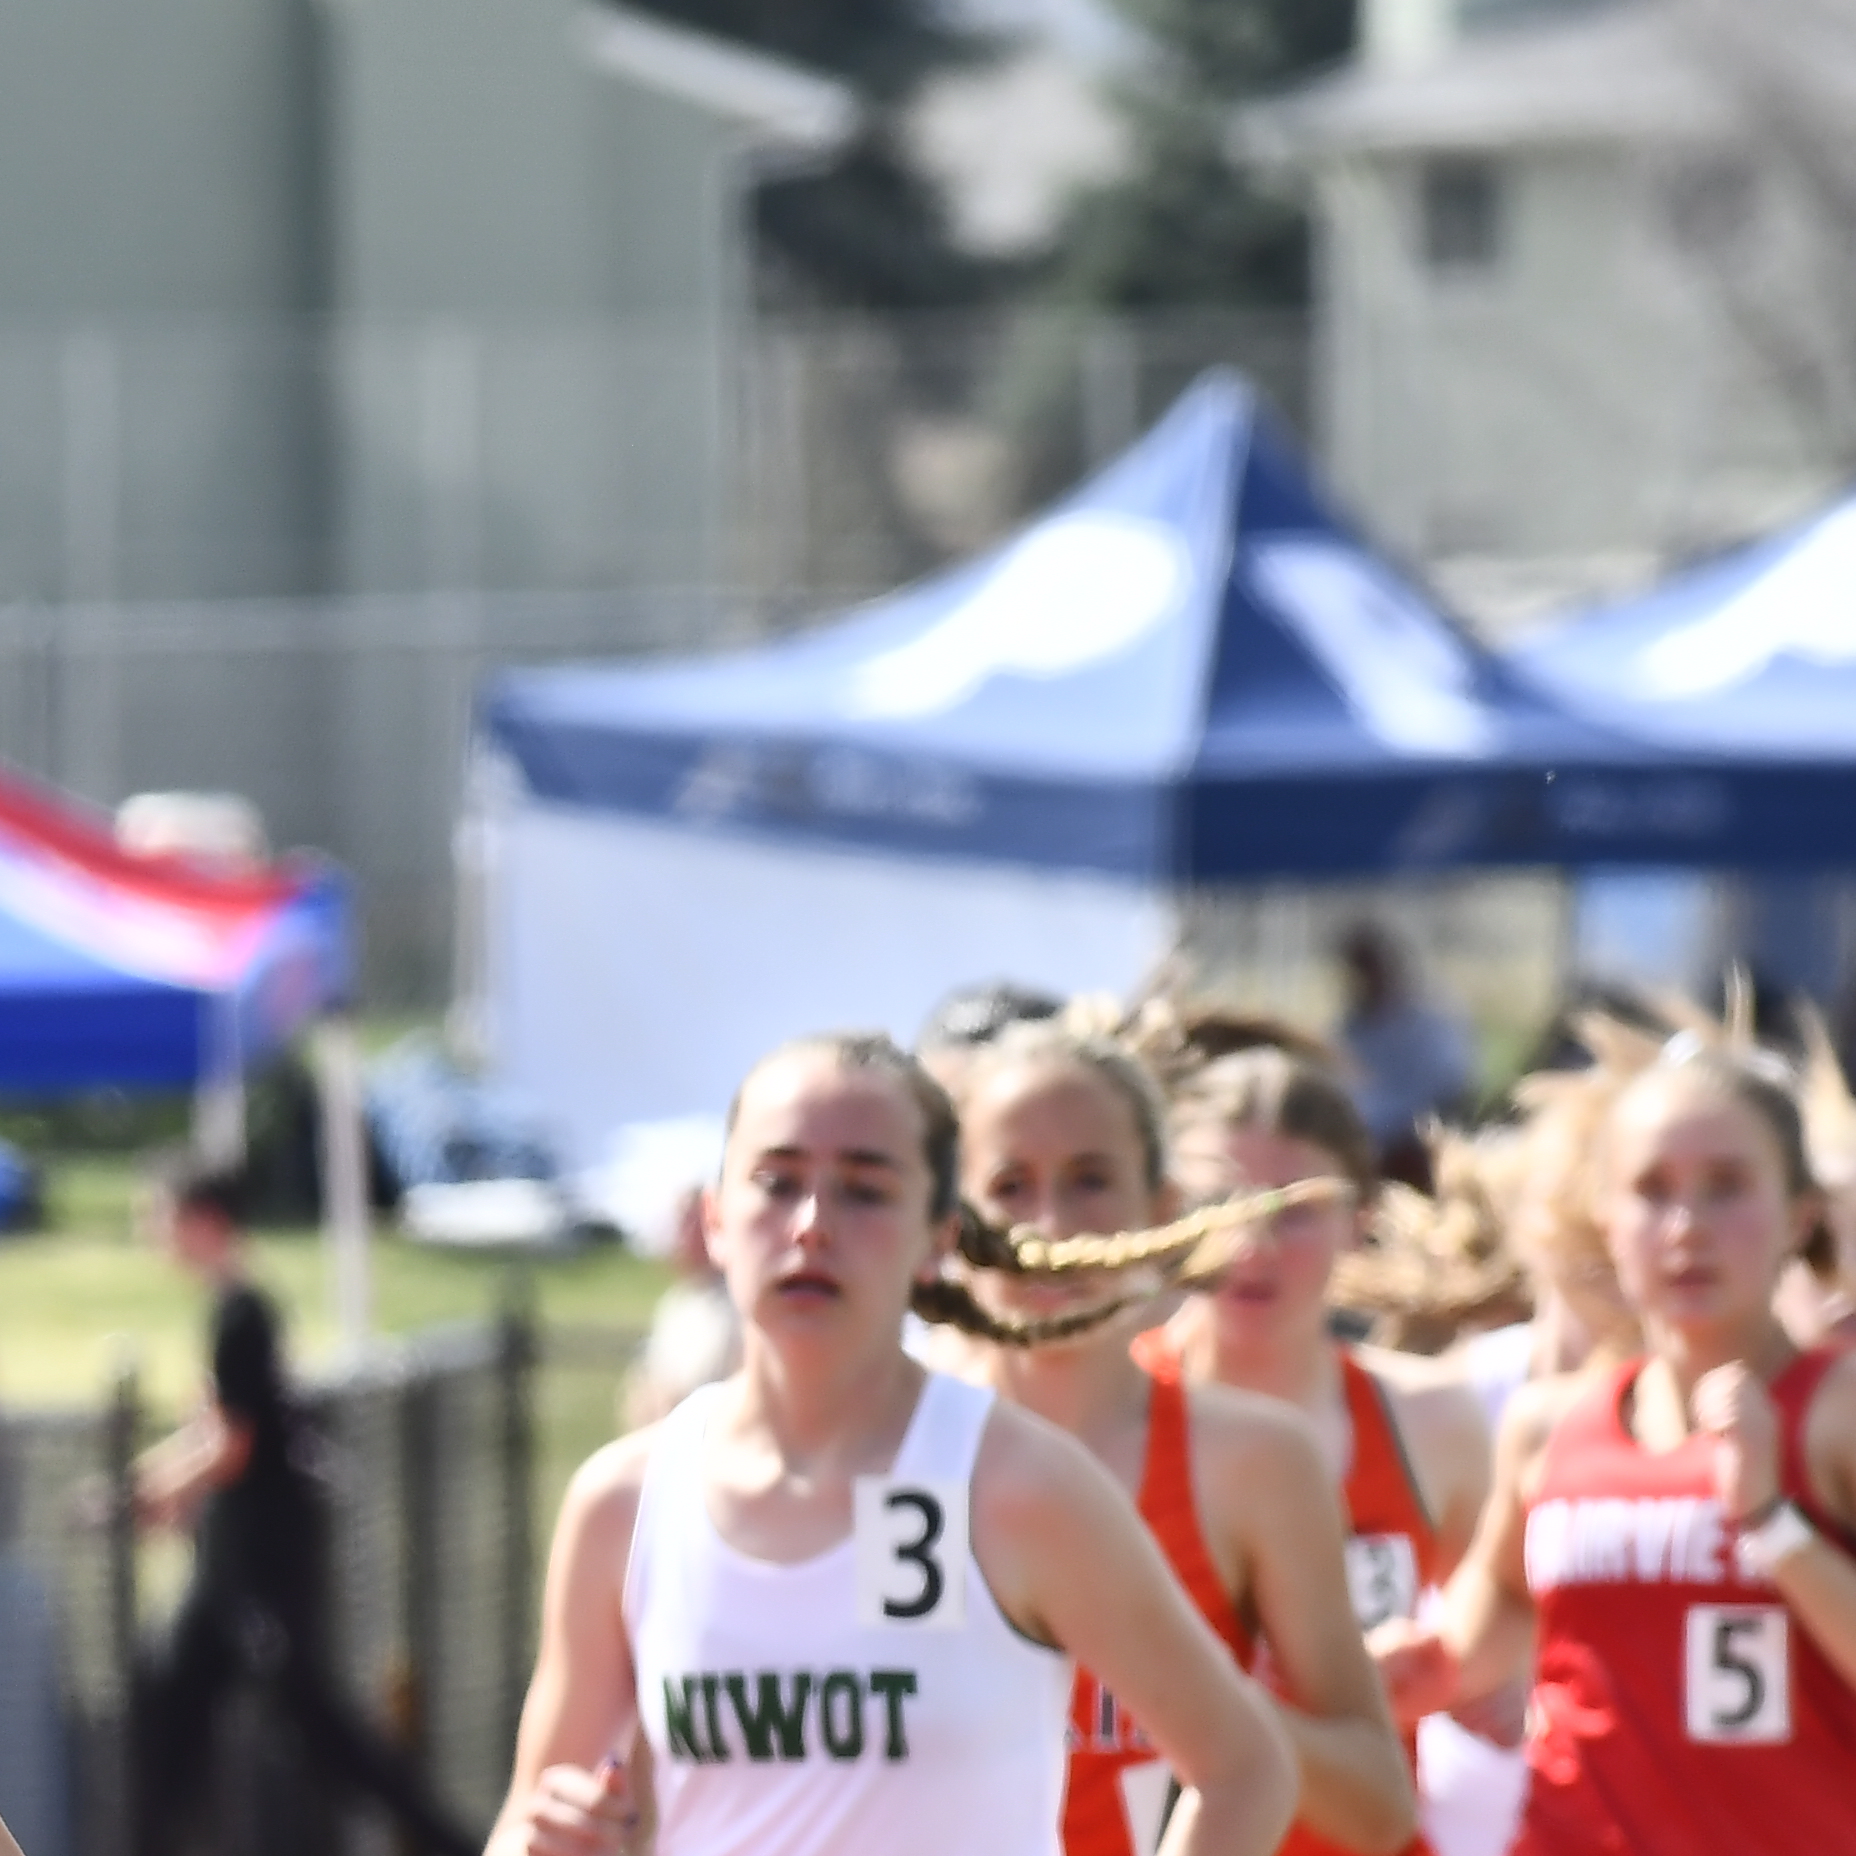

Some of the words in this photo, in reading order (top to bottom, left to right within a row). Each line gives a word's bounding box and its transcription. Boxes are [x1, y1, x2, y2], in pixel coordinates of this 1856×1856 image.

[885, 1489, 944, 1618] 3
[662, 1670, 918, 1764] NIWOT
[1711, 1617, 1767, 1728] 5
